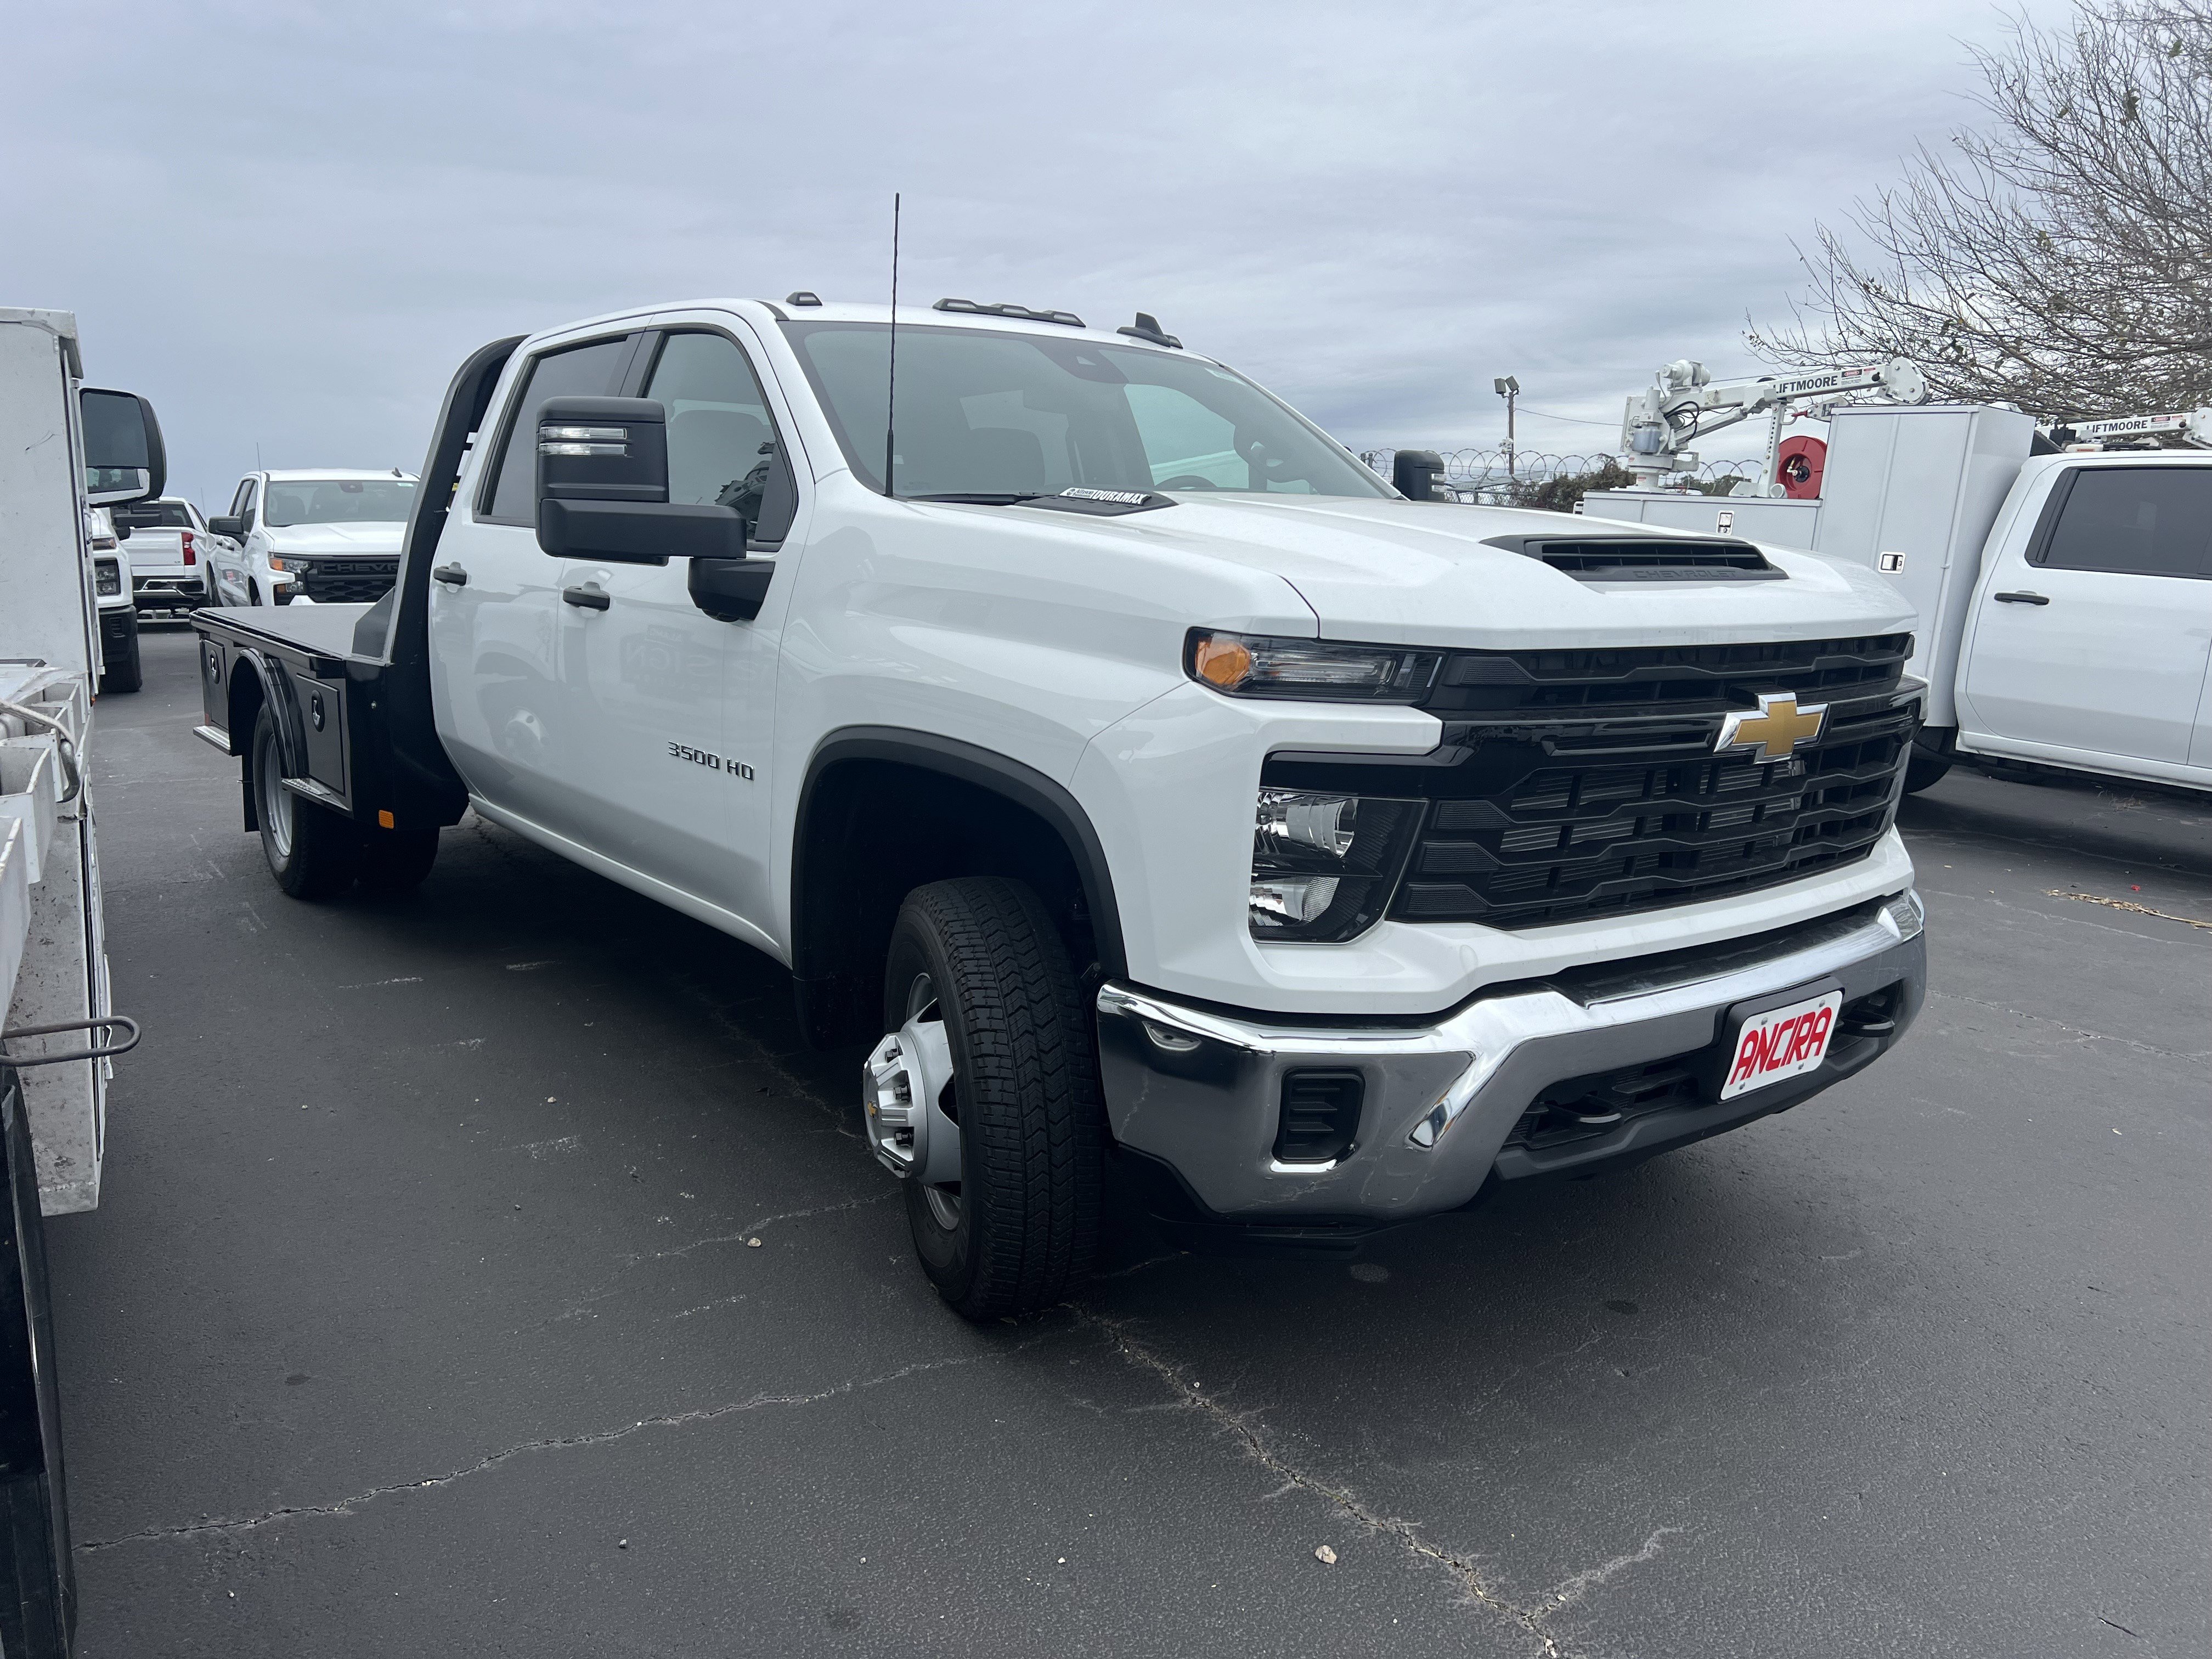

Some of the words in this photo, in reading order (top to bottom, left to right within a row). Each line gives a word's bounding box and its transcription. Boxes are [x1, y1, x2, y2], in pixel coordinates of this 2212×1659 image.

[2086, 420, 2148, 433] IFTMOORE
[1092, 490, 1148, 505] DURAMAX
[1633, 570, 1735, 578] CHEVROLET
[668, 740, 721, 770] 3500
[727, 757, 755, 782] HD
[1729, 1007, 1832, 1086] ANCIRA
